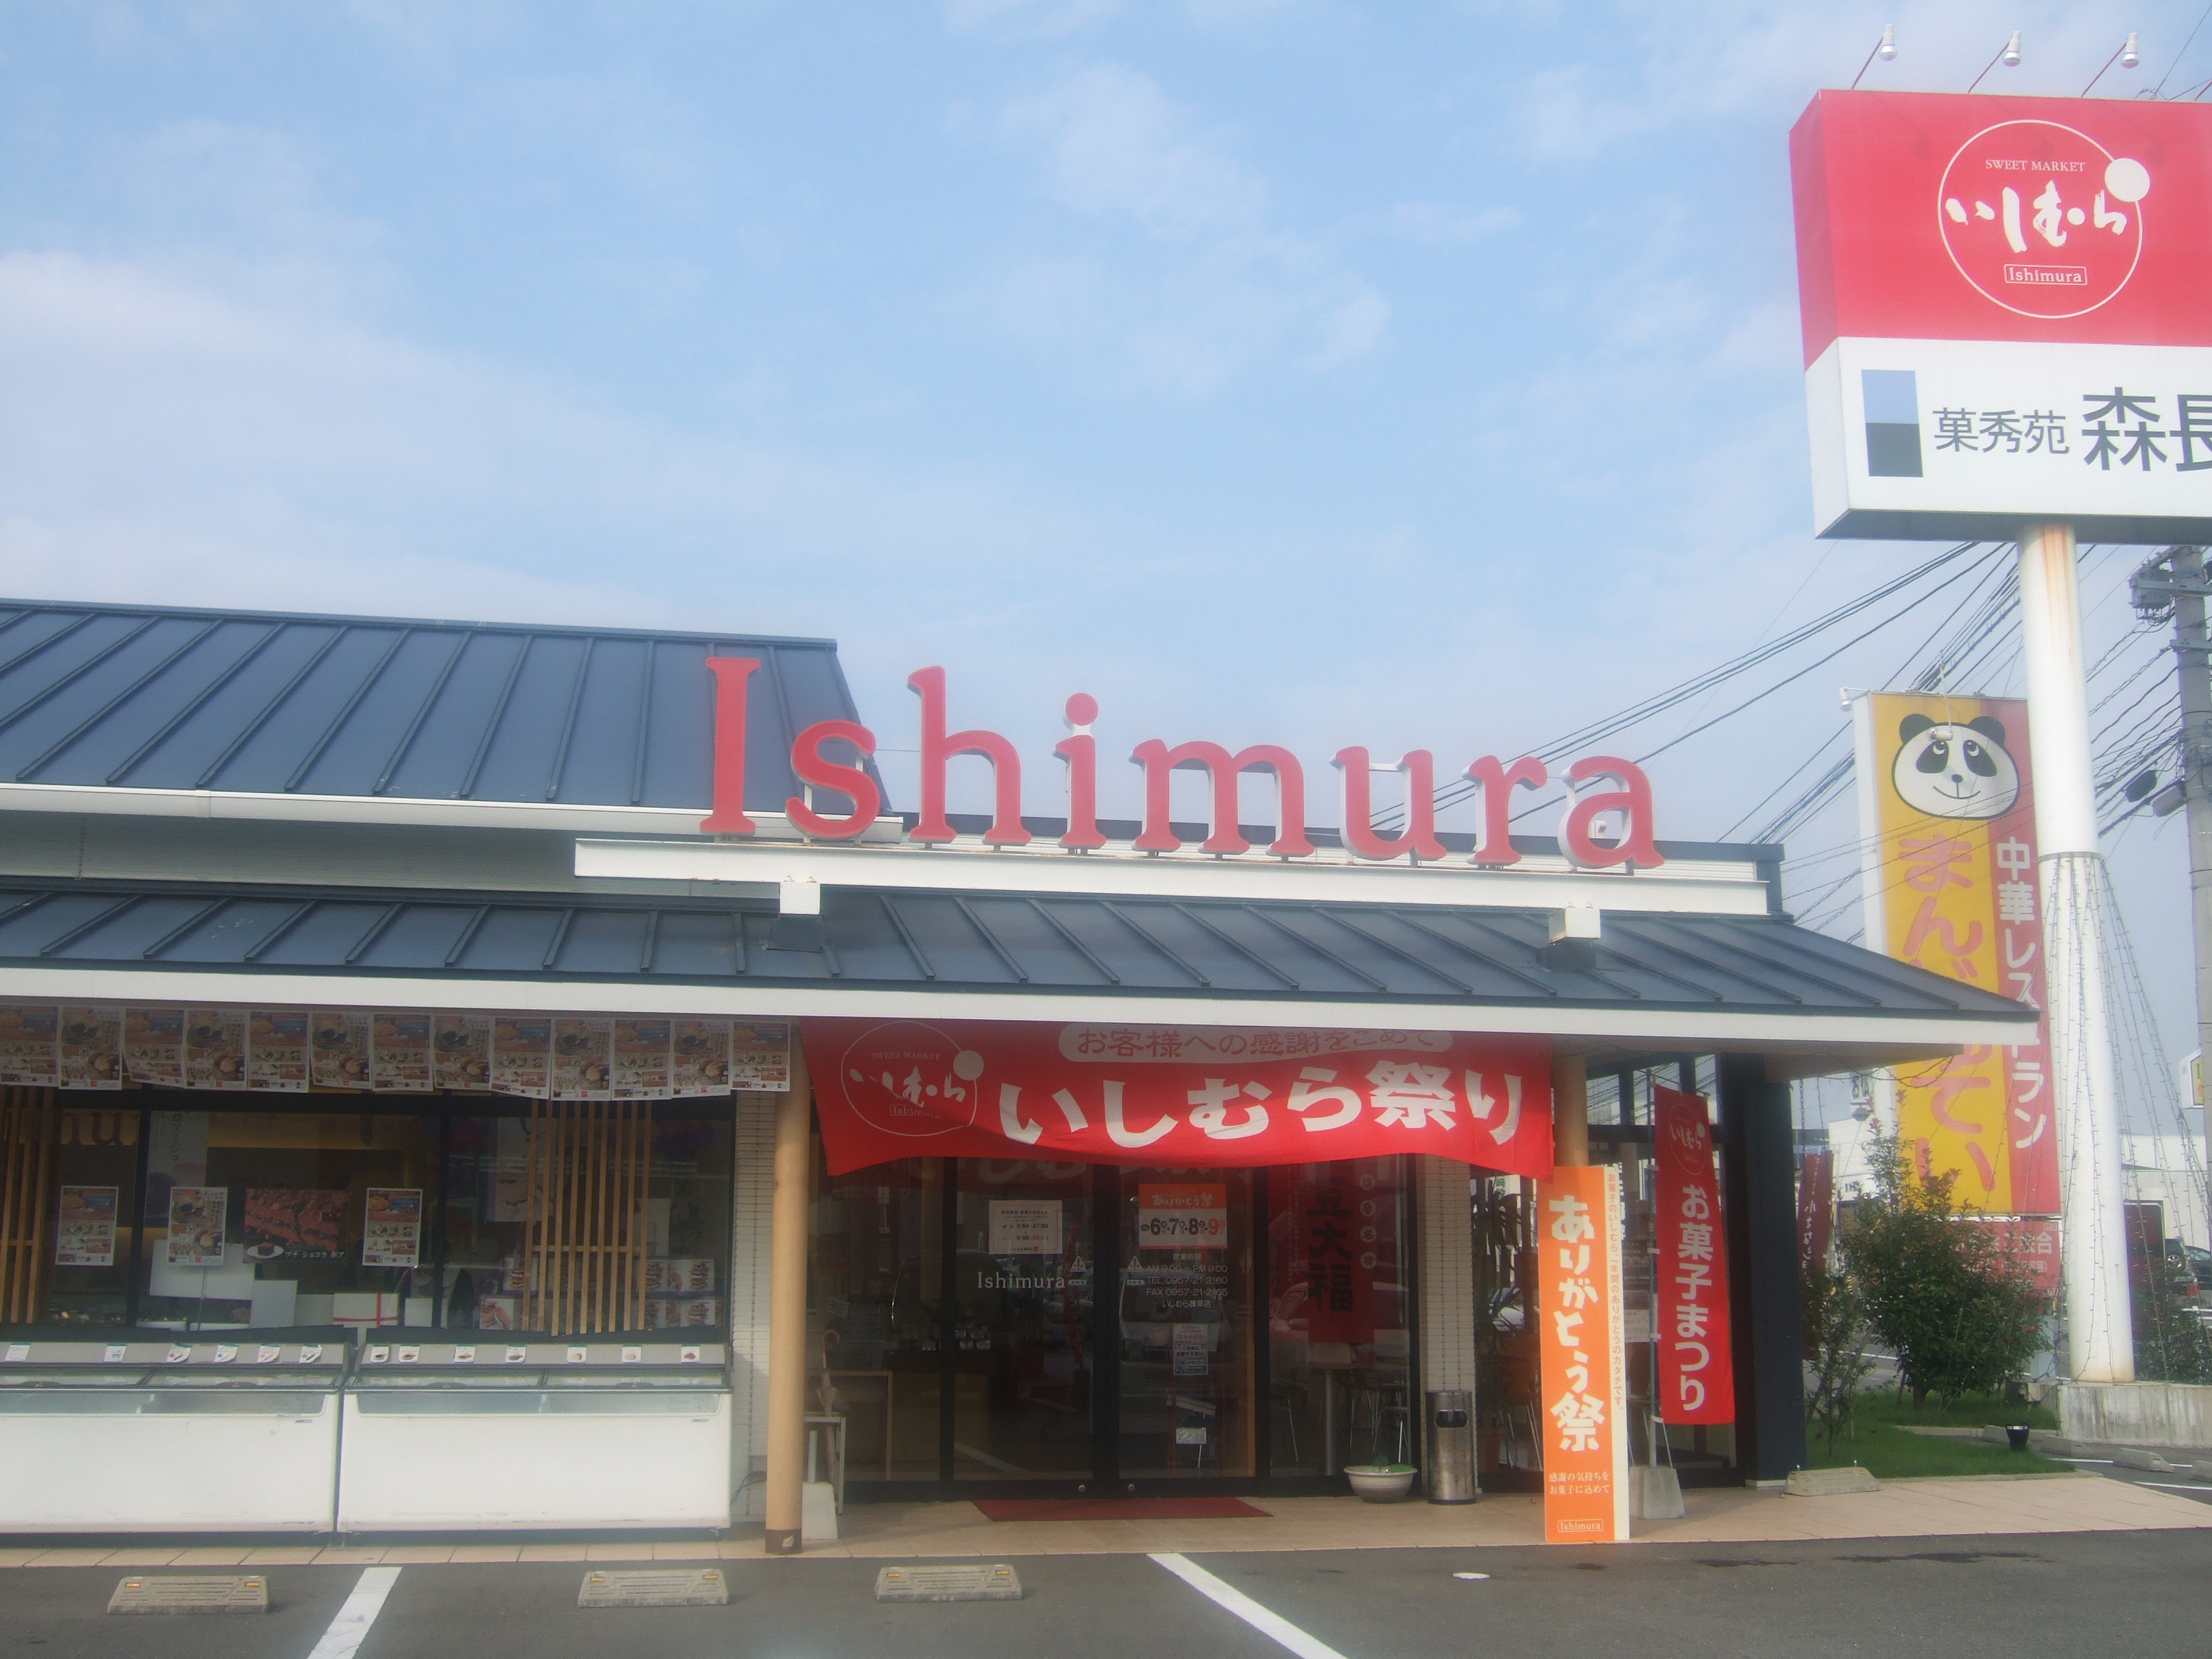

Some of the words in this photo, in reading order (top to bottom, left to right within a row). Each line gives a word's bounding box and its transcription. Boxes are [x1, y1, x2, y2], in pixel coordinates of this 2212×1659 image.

[1984, 159, 2028, 171] SWEET
[2031, 161, 2086, 173] MARKET
[1945, 180, 2127, 253] いしむら
[2009, 266, 2083, 285] Ishimura
[1932, 407, 2071, 455] 菓秀苑
[699, 656, 1665, 871] Ishimura
[1077, 1027, 1436, 1059] お客様への感謝をこめて
[903, 1052, 941, 1060] MARKET
[999, 1060, 1523, 1148] いしむら祭り
[977, 1271, 1066, 1289] Ishimura
[1675, 1183, 1714, 1412] お菓子まつり
[1549, 1195, 1605, 1452] ありがとう祭
[1549, 1470, 1610, 1483] 感謝の気持ちを
[1549, 1483, 1610, 1495] お菓子に込めて
[1560, 1521, 1601, 1531] Ishimura
